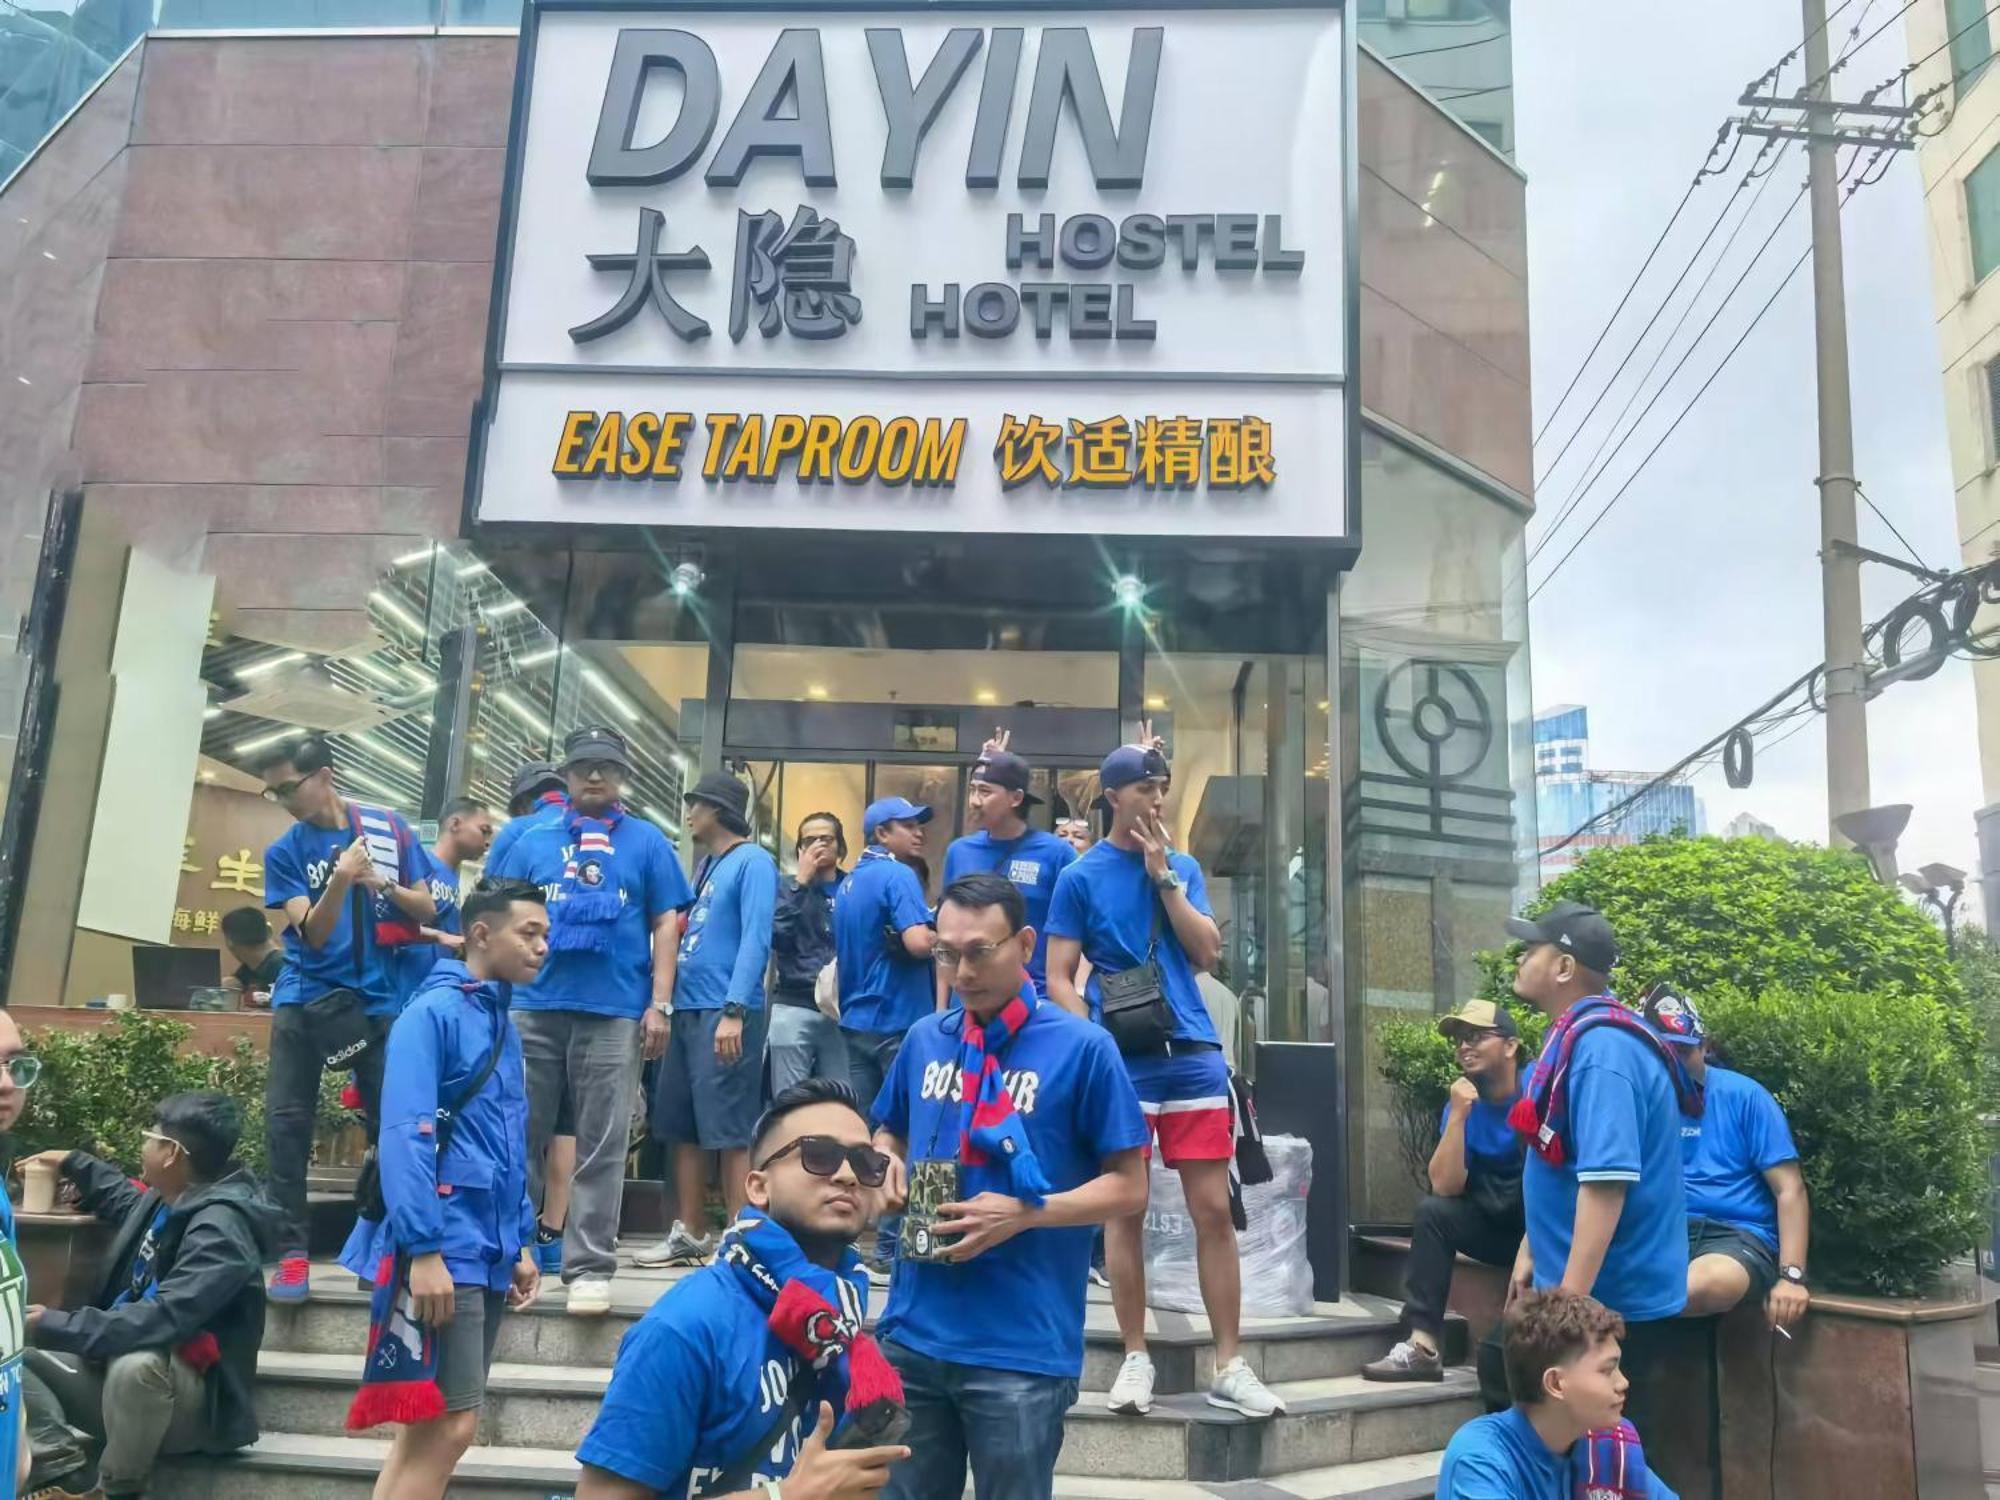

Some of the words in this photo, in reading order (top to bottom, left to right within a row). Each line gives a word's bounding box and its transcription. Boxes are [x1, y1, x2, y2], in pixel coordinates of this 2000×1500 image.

[586, 27, 1164, 189] DAYIN
[568, 204, 863, 345] 大隐
[1006, 213, 1306, 271] HOSTEL
[911, 282, 1157, 339] HOTEL
[552, 411, 694, 481] EASE
[701, 413, 968, 488] TAPROOM
[993, 413, 1277, 492] 饮适精酿
[326, 1039, 367, 1065] adidas
